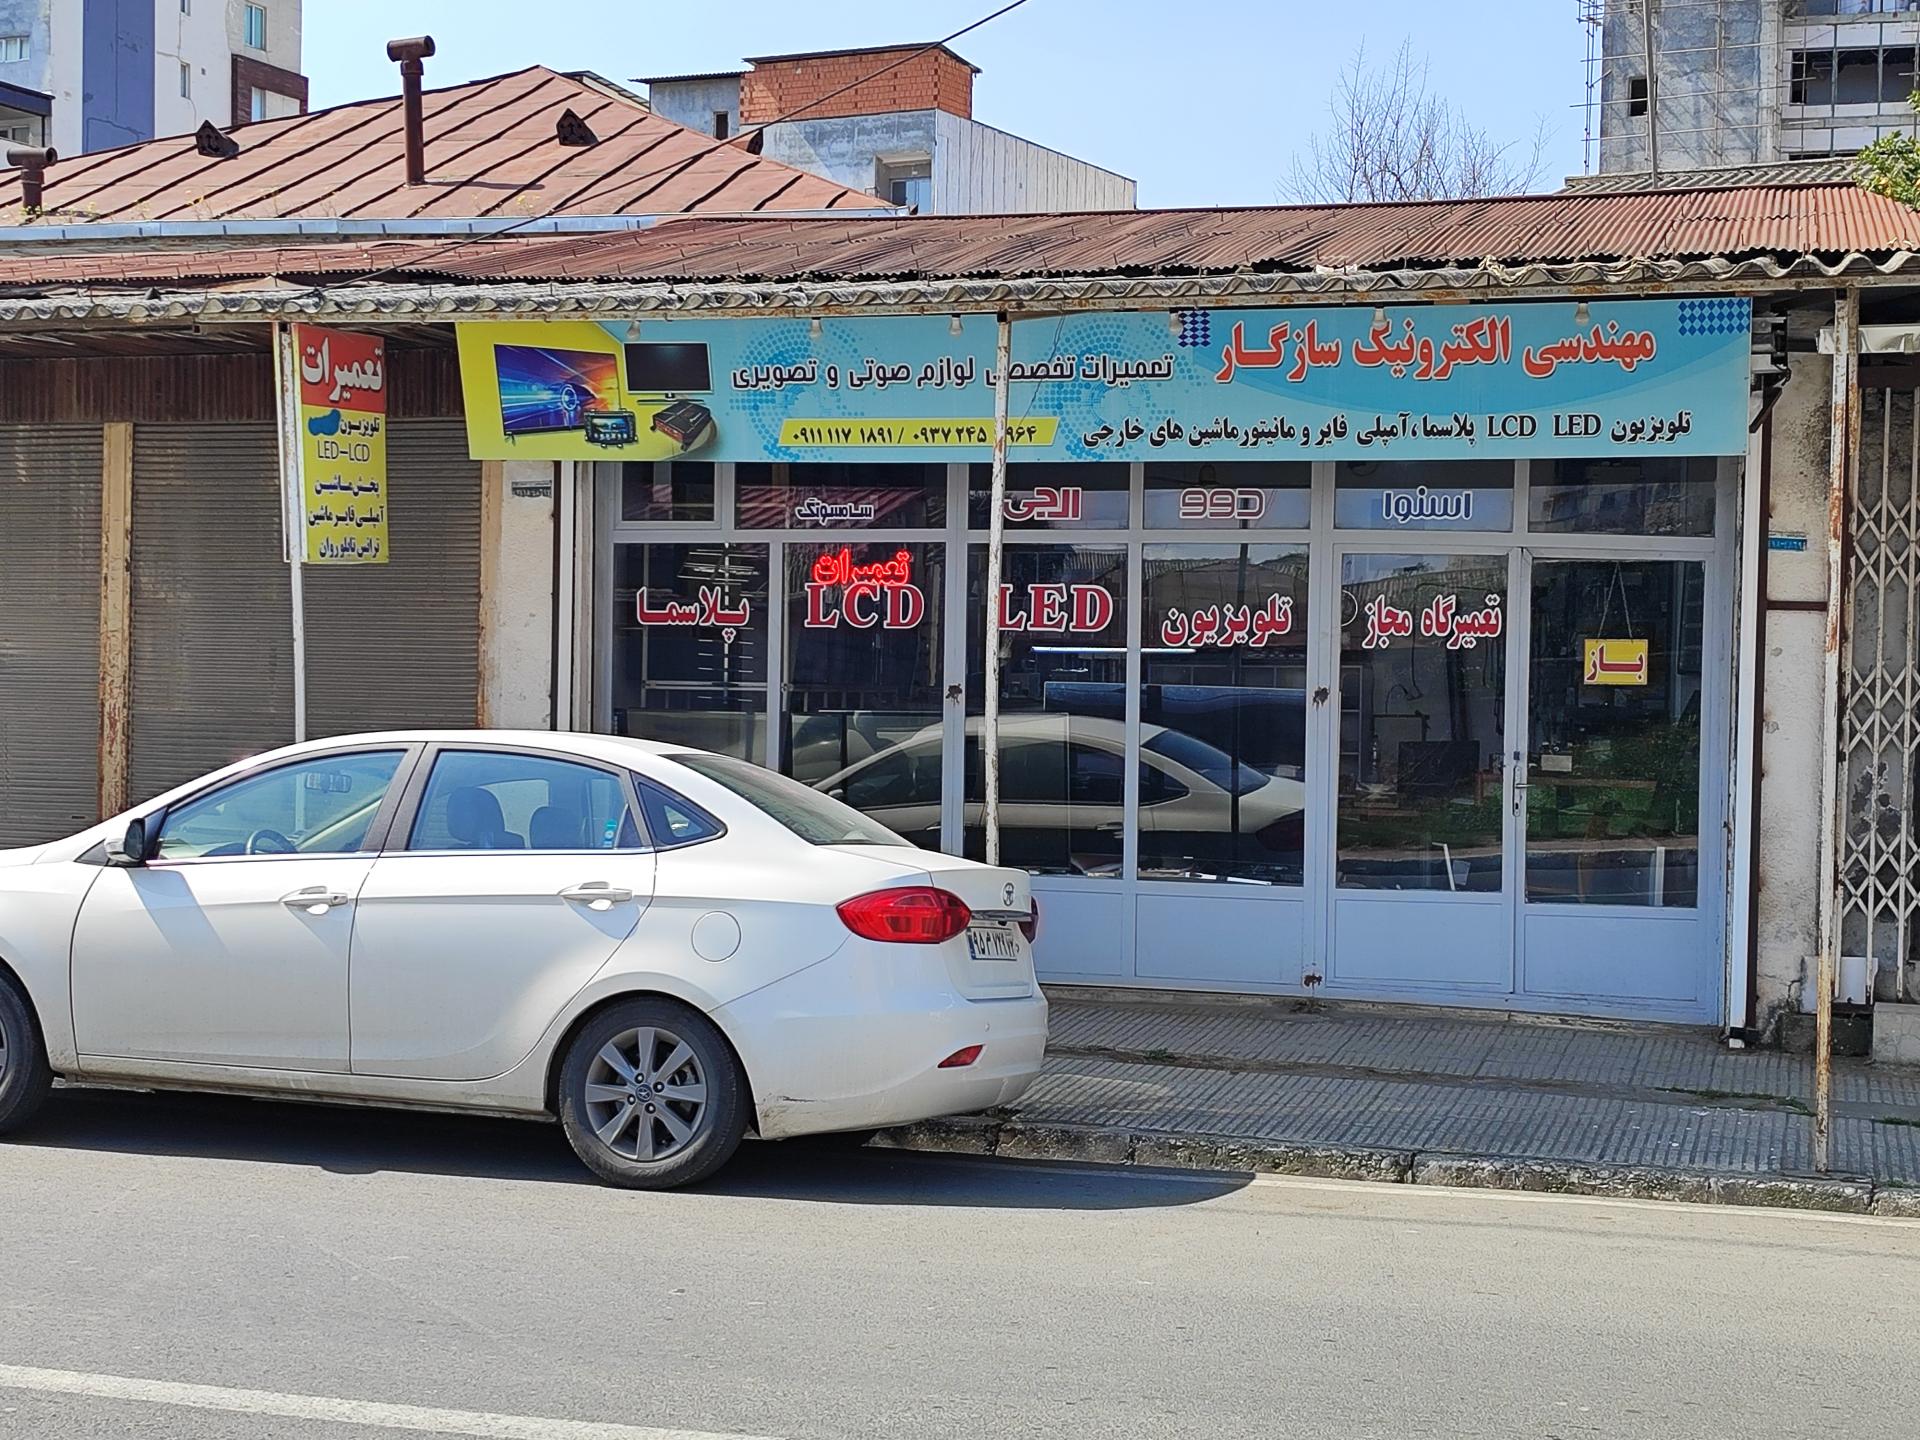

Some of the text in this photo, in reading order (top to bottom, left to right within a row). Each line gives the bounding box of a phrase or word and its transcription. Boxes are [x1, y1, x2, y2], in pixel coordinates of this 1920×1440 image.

[1215, 317, 1656, 383] مهندسی الکترونیک سازگار
[302, 336, 383, 402] تعمیرات
[732, 358, 819, 390] تصویری
[827, 362, 839, 388] و
[849, 358, 911, 389] صوتی
[915, 356, 976, 389] لوازم
[1082, 353, 1174, 387] تعمیرات
[340, 417, 380, 438] تلویزیون
[1083, 415, 1146, 448] خارجی
[1149, 416, 1184, 448] های
[1300, 423, 1311, 446] و
[1314, 414, 1348, 446] فایر
[1487, 415, 1537, 438] LCD
[1553, 414, 1602, 437] LED
[1611, 410, 1693, 442] تلویزیون
[317, 440, 371, 462] LED-LCD
[795, 498, 875, 525] سامسونگ
[1383, 486, 1472, 523] اسنوا
[813, 547, 911, 595] تعمیرات
[636, 582, 1293, 647] تلویزیون LED LCD پلاسما
[1362, 593, 1502, 649] تعمیرگاه مجاز
[1586, 643, 1645, 683] باز
